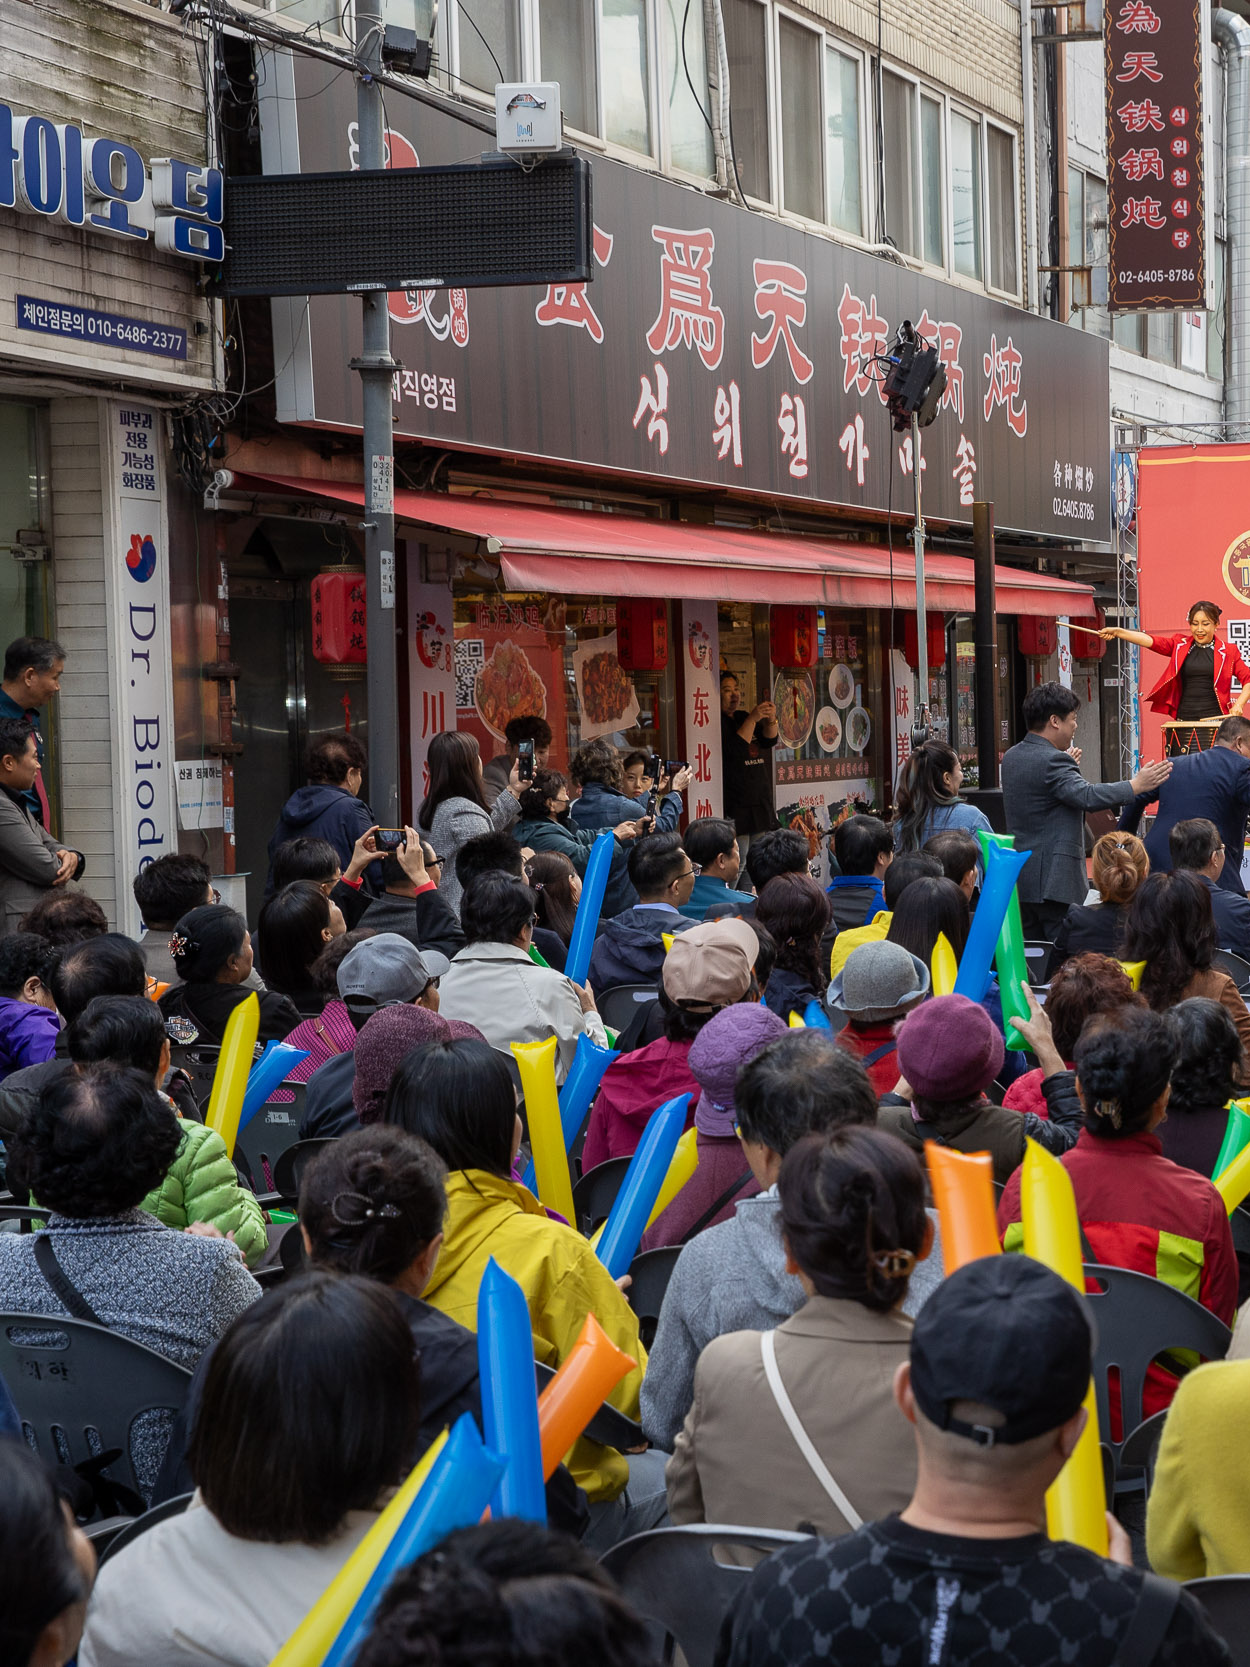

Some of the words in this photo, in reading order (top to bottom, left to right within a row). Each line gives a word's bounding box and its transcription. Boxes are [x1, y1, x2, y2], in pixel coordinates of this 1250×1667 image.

[1119, 268, 1195, 284] 02-6405-8786
[24, 303, 84, 334] 체인점문의
[87, 319, 182, 351] 010-6486-2377
[126, 431, 148, 449] 전용
[129, 602, 156, 687] Dr.
